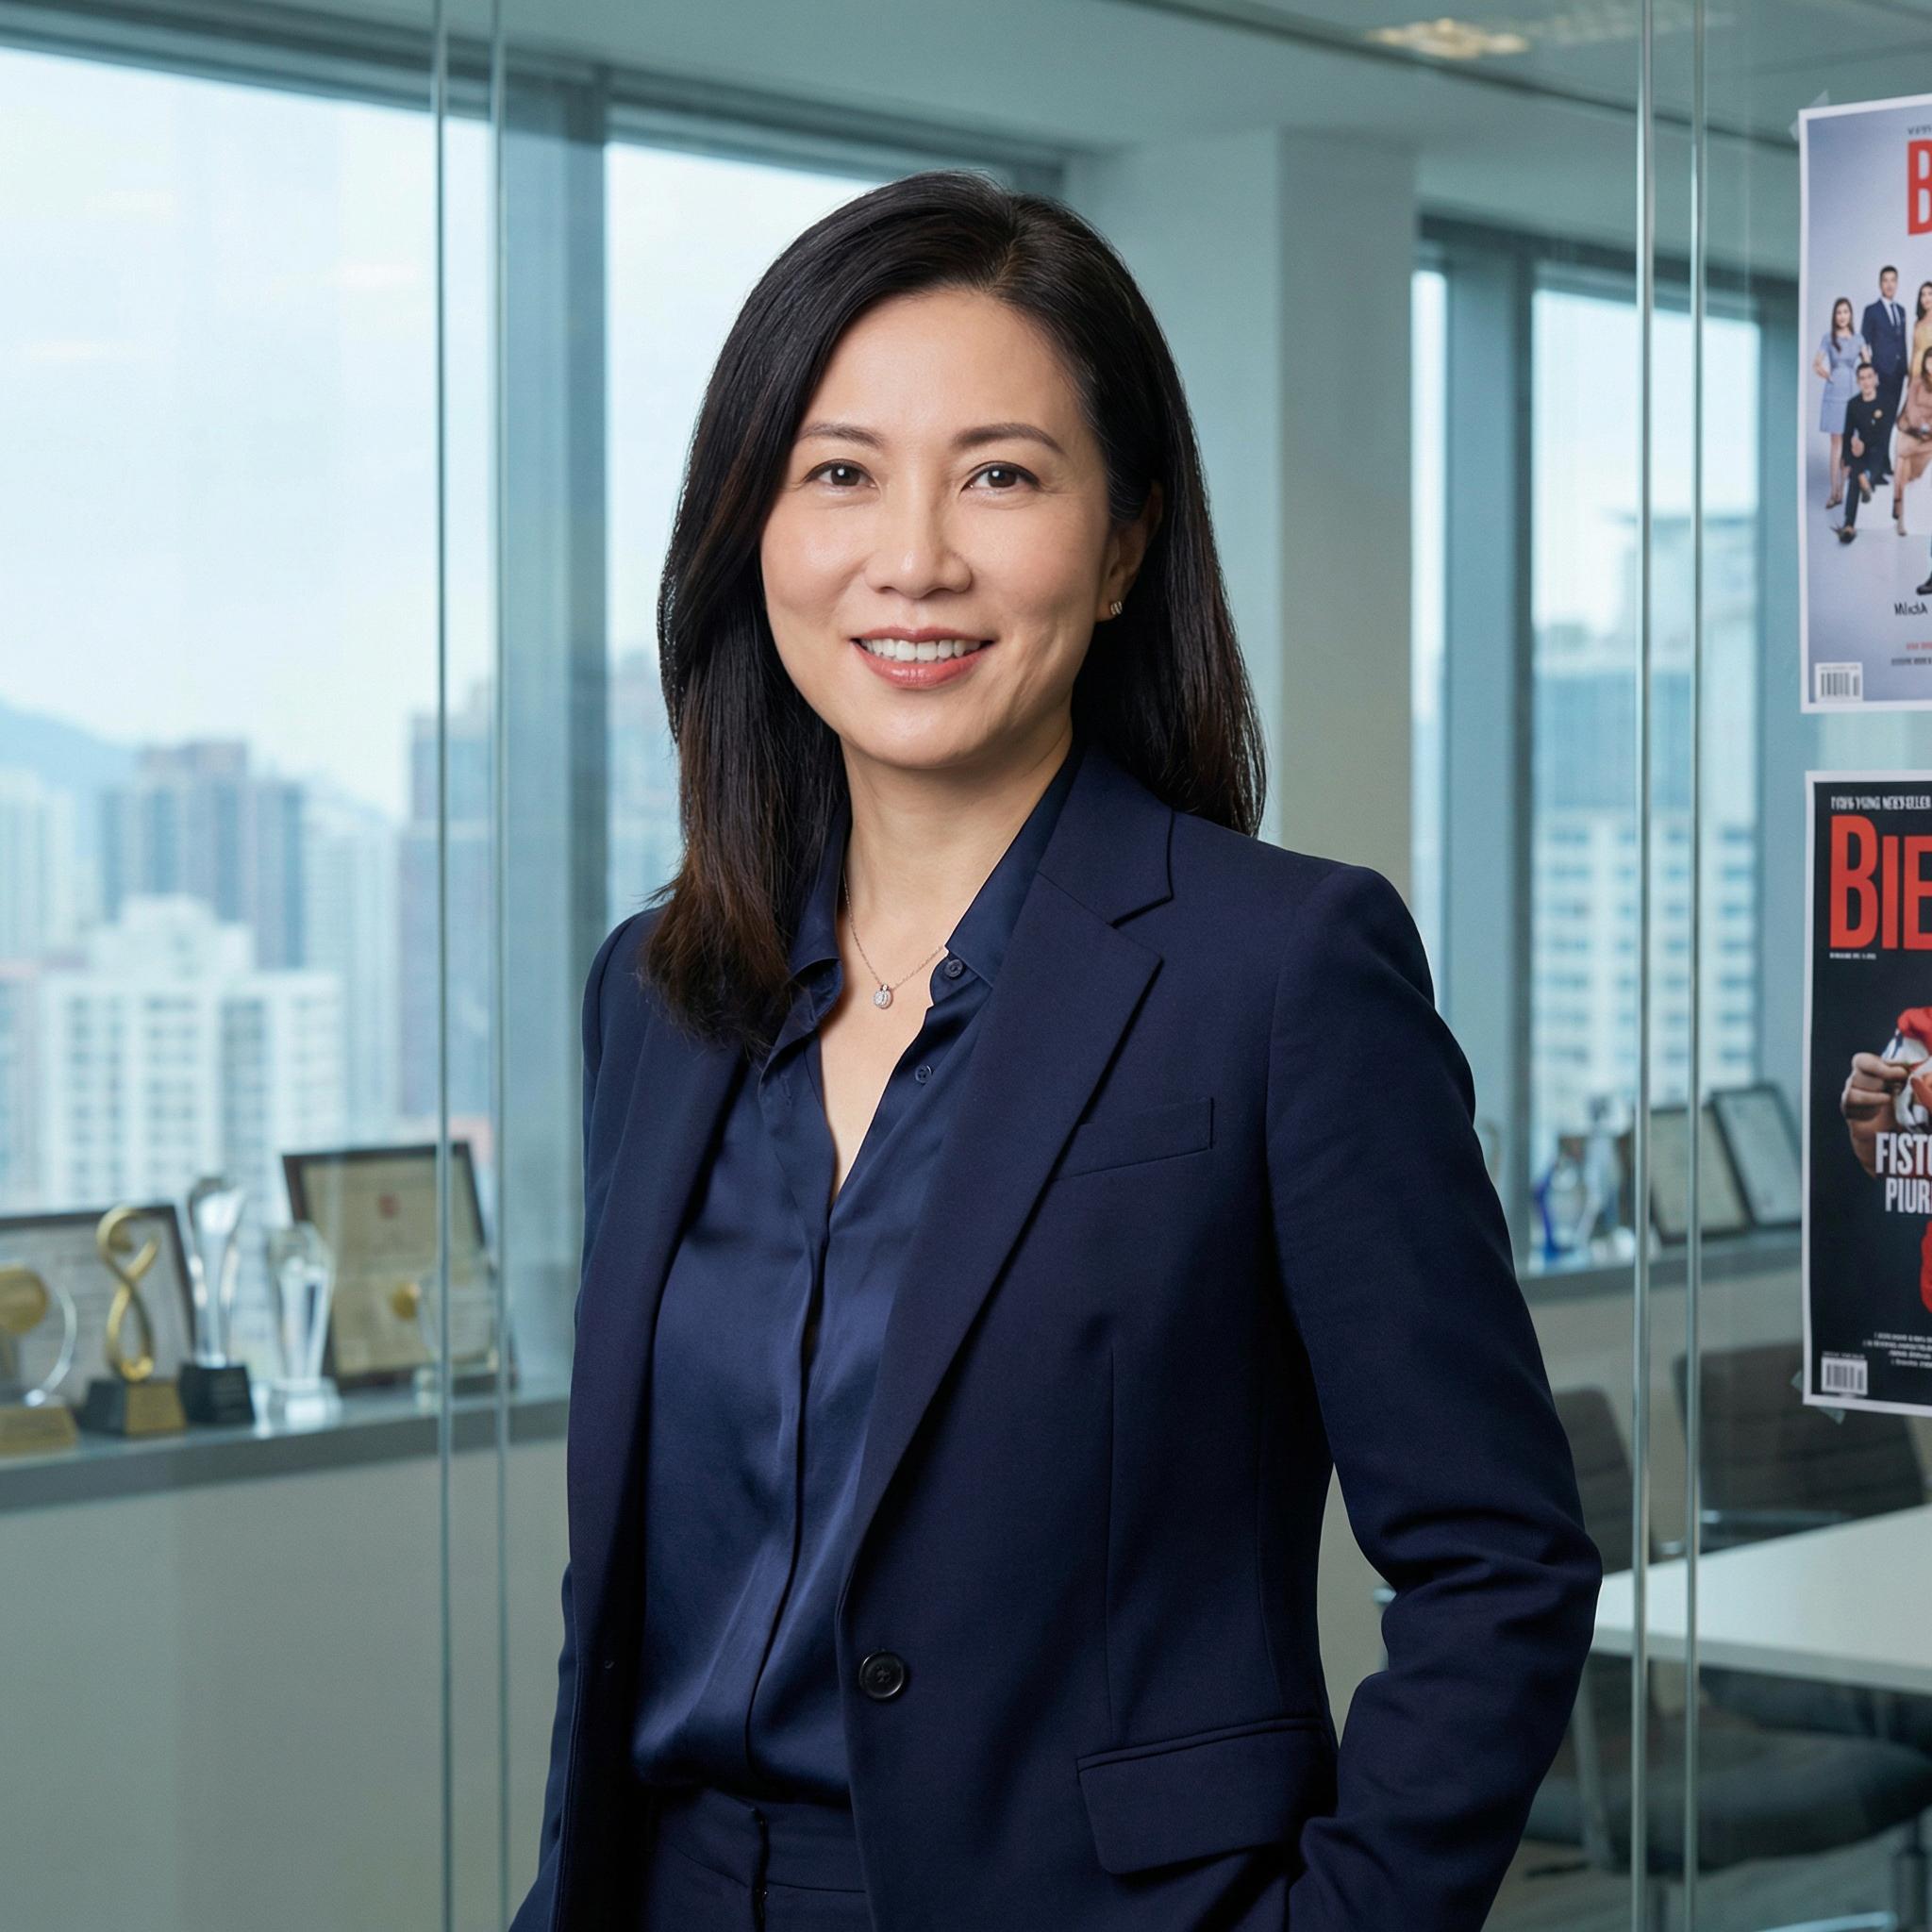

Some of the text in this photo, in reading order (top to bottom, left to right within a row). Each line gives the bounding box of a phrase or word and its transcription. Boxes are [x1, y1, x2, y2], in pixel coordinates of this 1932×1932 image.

[1907, 139, 1932, 236] B
[1830, 815, 1932, 950] BIE
[1885, 1177, 1932, 1214] PIUR
